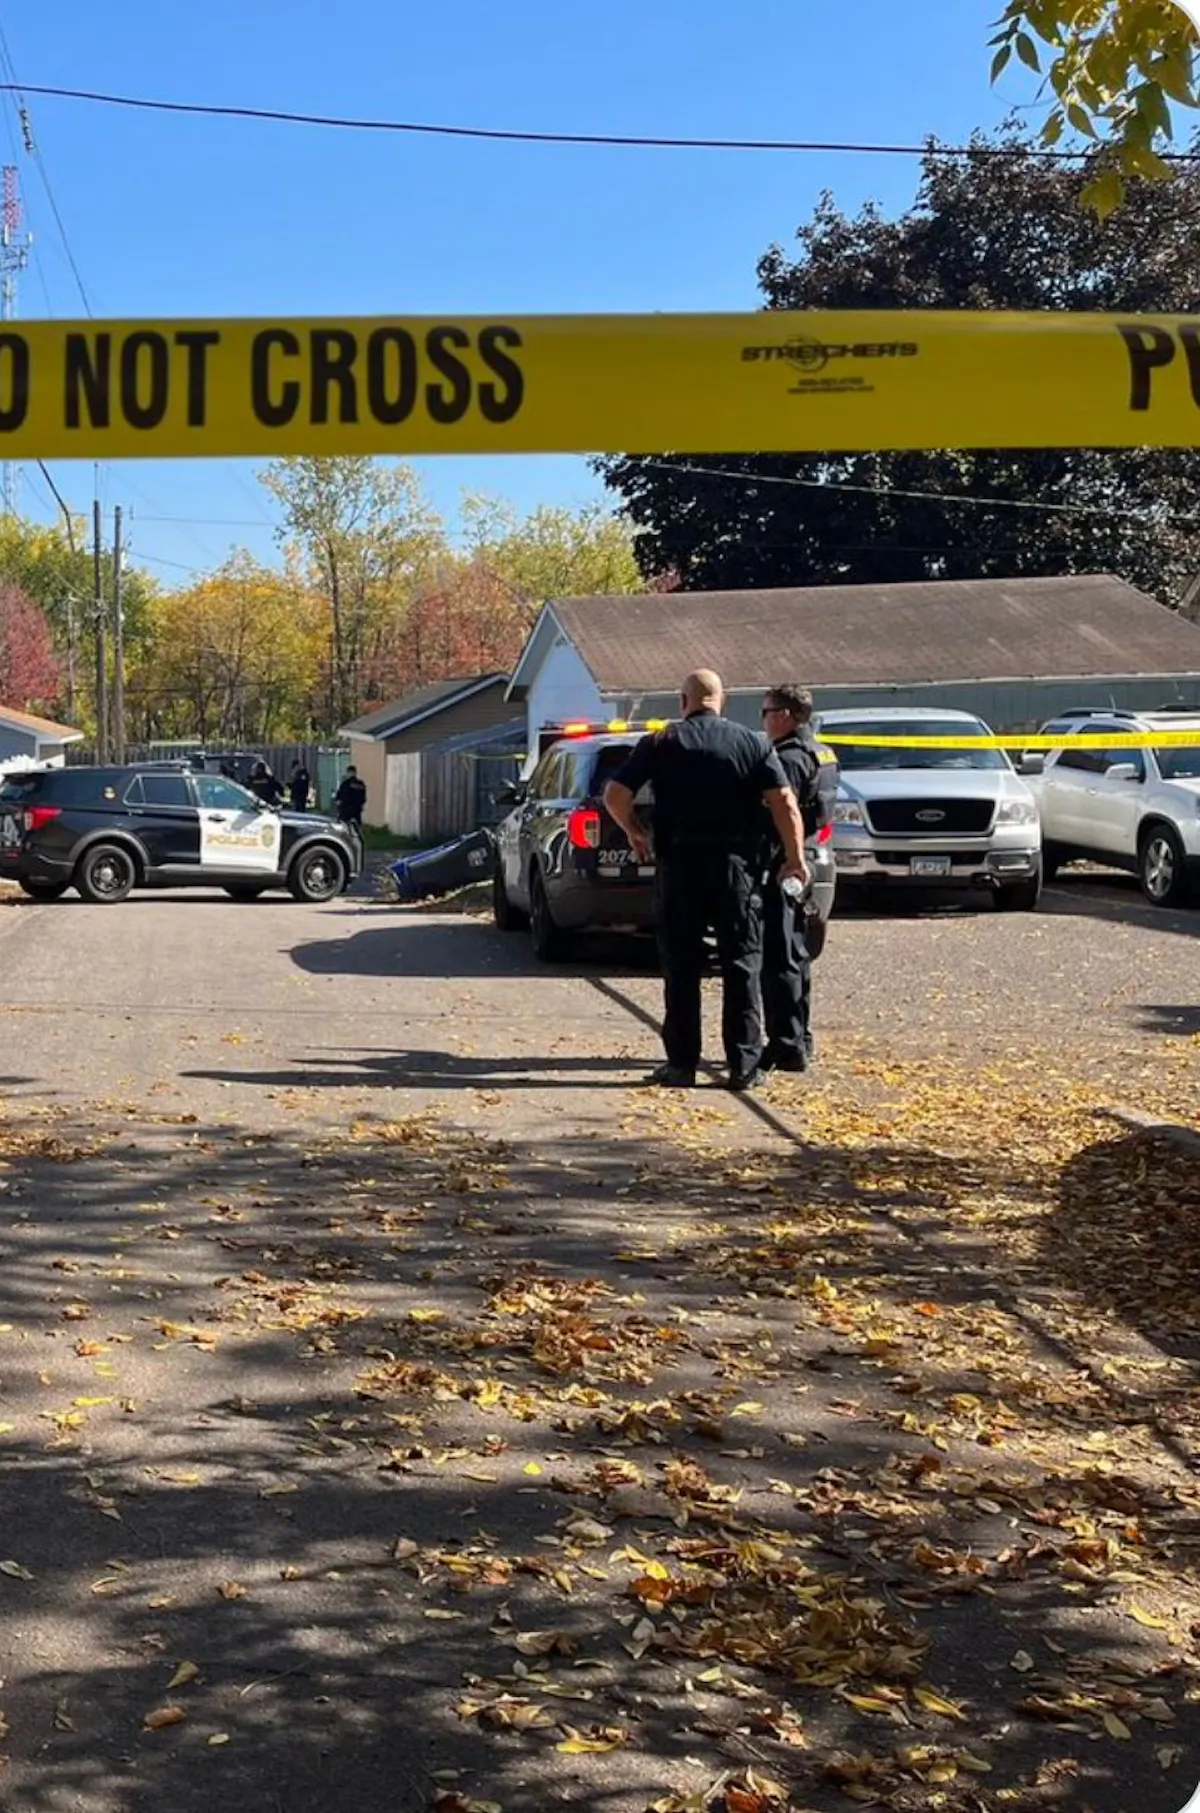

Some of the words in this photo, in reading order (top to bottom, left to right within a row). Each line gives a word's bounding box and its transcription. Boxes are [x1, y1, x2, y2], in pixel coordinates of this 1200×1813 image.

[64, 331, 220, 429] NOT
[251, 326, 523, 427] CROSS
[206, 834, 259, 846] POLICE
